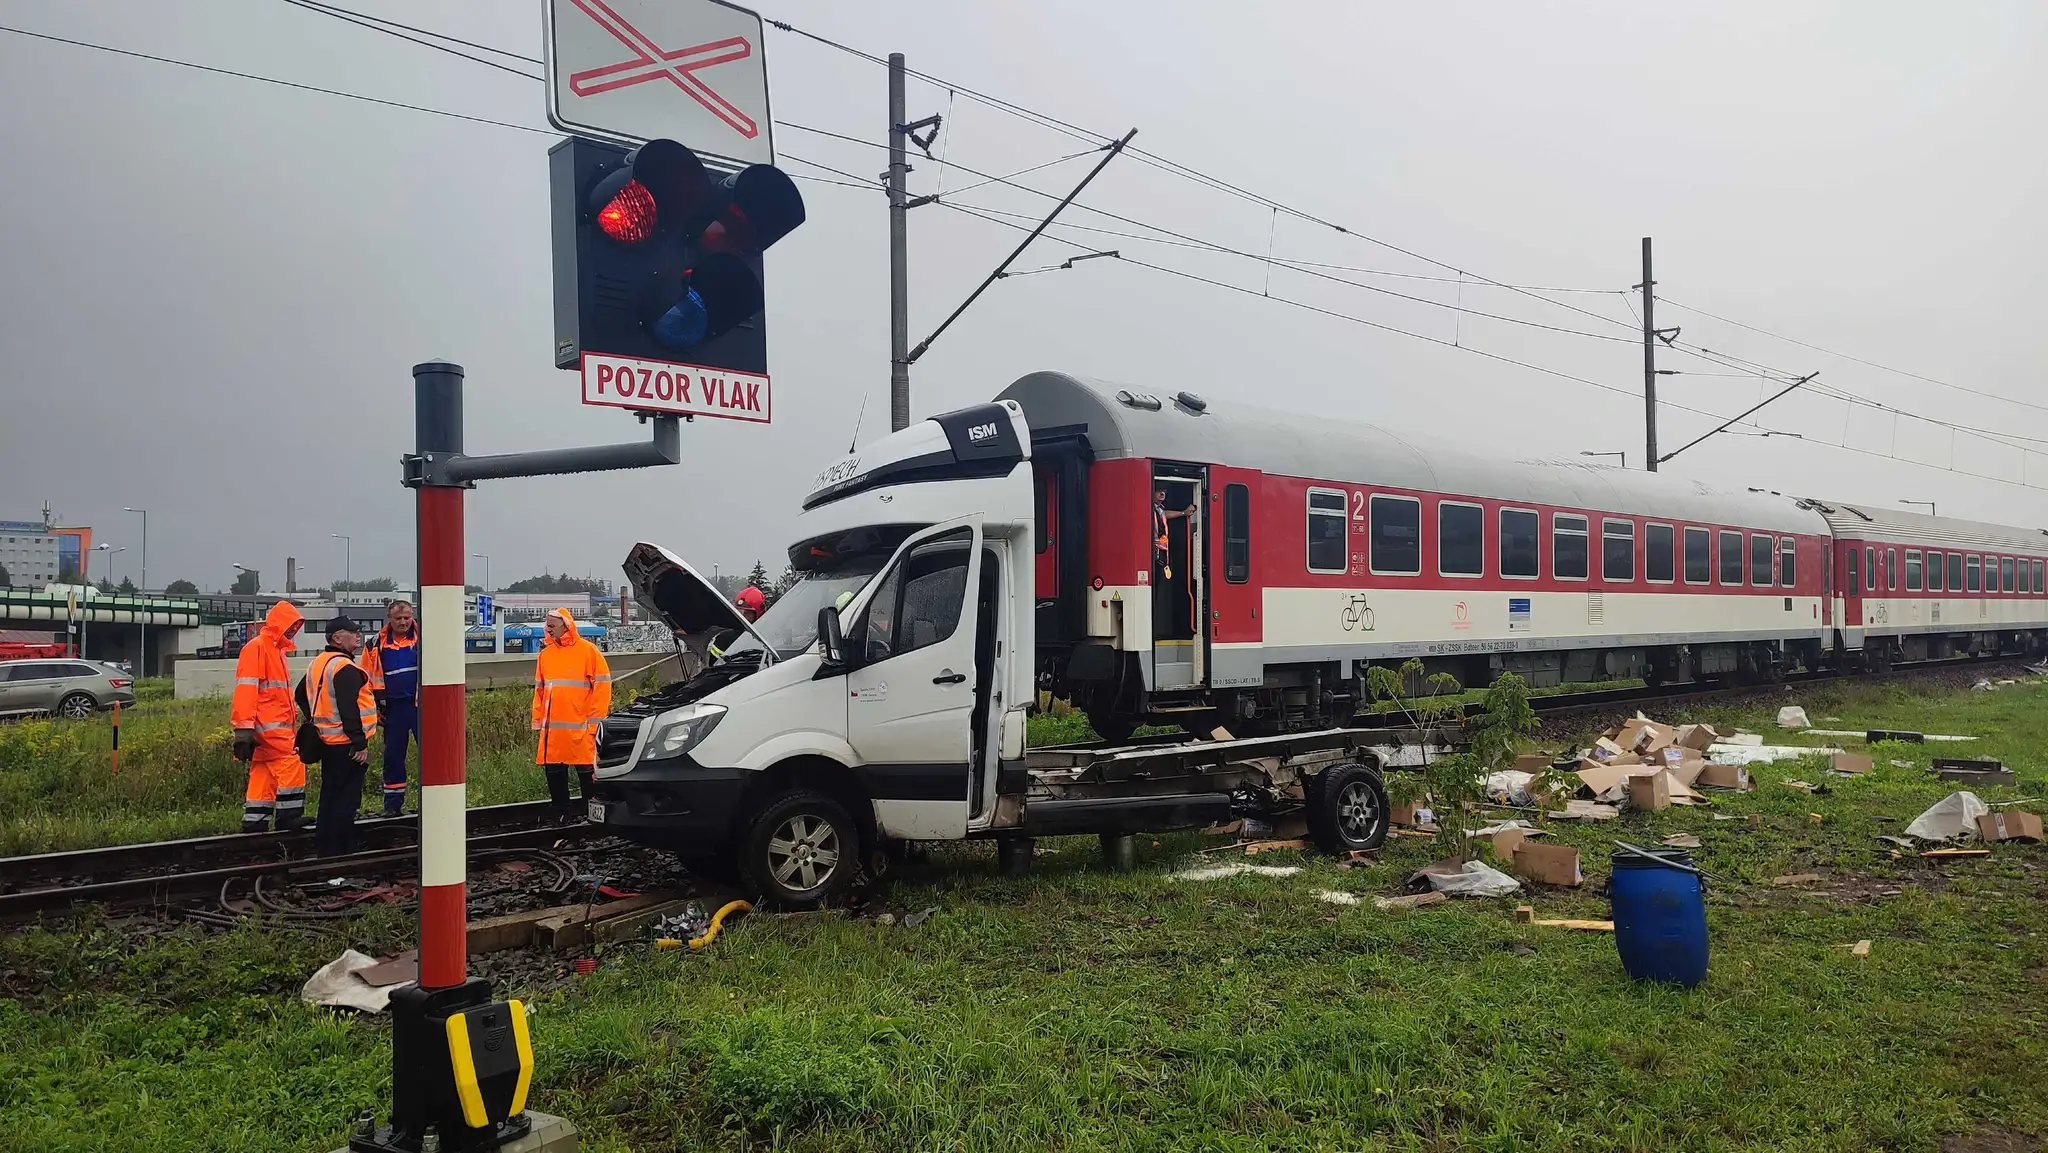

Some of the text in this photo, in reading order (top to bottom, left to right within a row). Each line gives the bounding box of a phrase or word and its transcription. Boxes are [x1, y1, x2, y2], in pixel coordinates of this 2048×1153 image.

[597, 364, 761, 412] POZOR VLAK
[968, 422, 997, 440] ISM
[1353, 491, 1364, 520] 2
[1774, 535, 1779, 554] 2
[1878, 550, 1884, 566] 2
